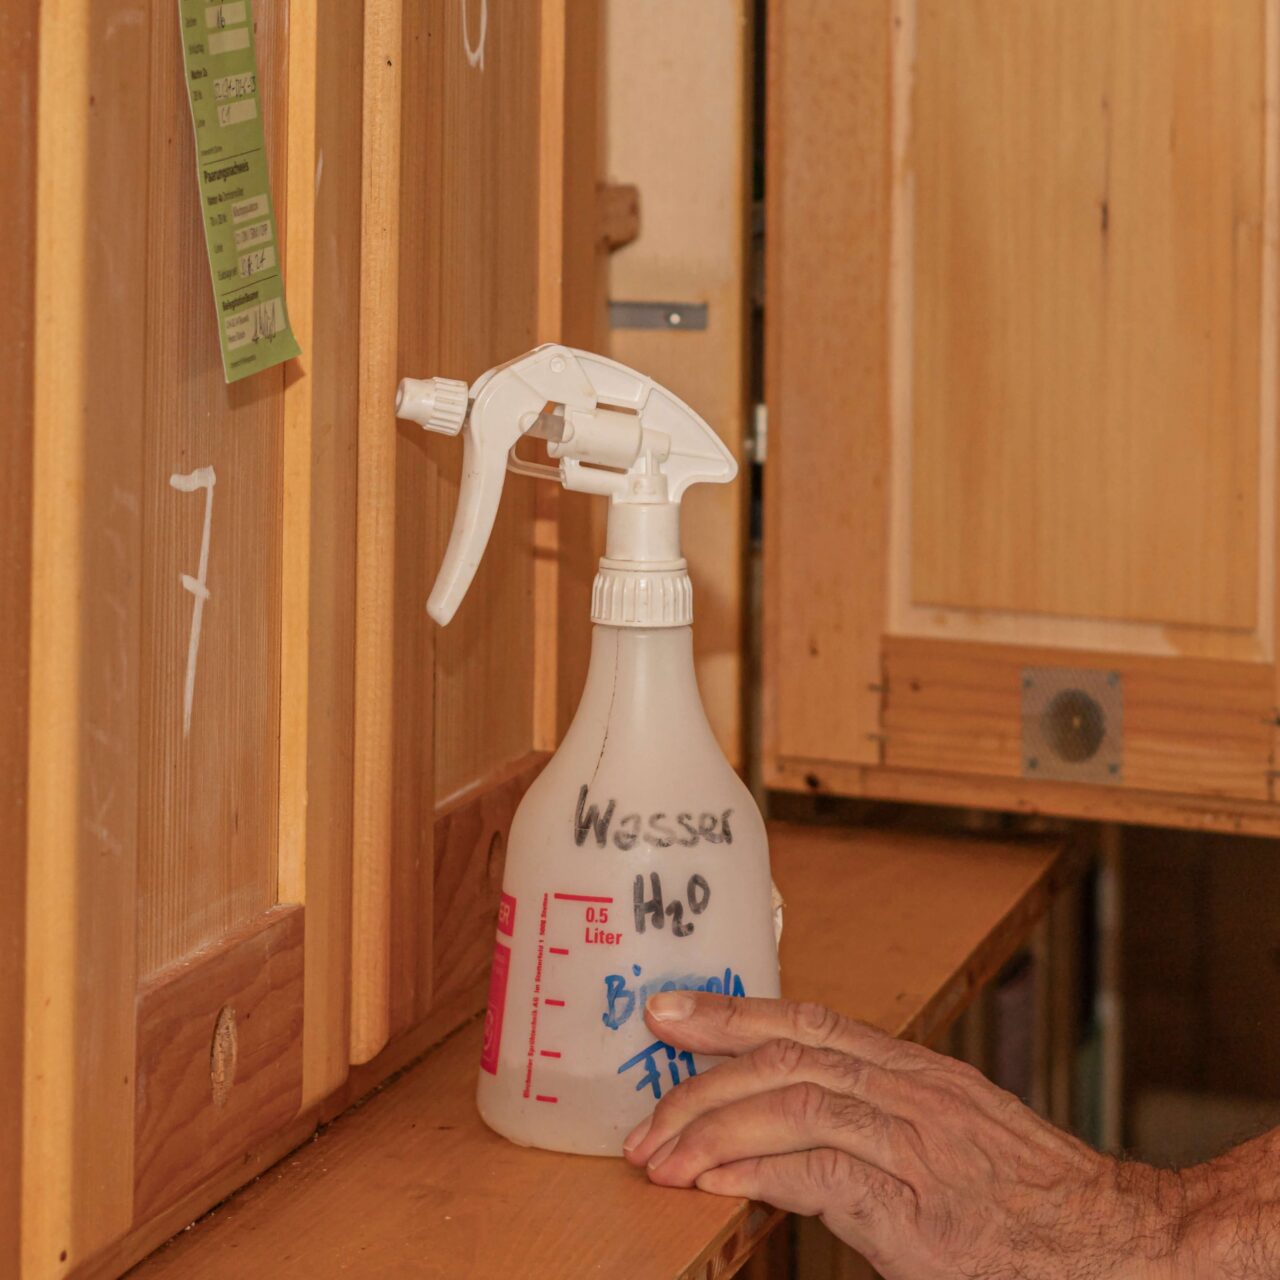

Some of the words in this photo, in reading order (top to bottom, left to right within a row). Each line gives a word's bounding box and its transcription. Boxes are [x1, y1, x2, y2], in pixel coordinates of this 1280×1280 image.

[169, 465, 217, 737] 7
[571, 784, 734, 851] Wasser
[585, 907, 609, 924] 0.5
[584, 928, 623, 946] Liter
